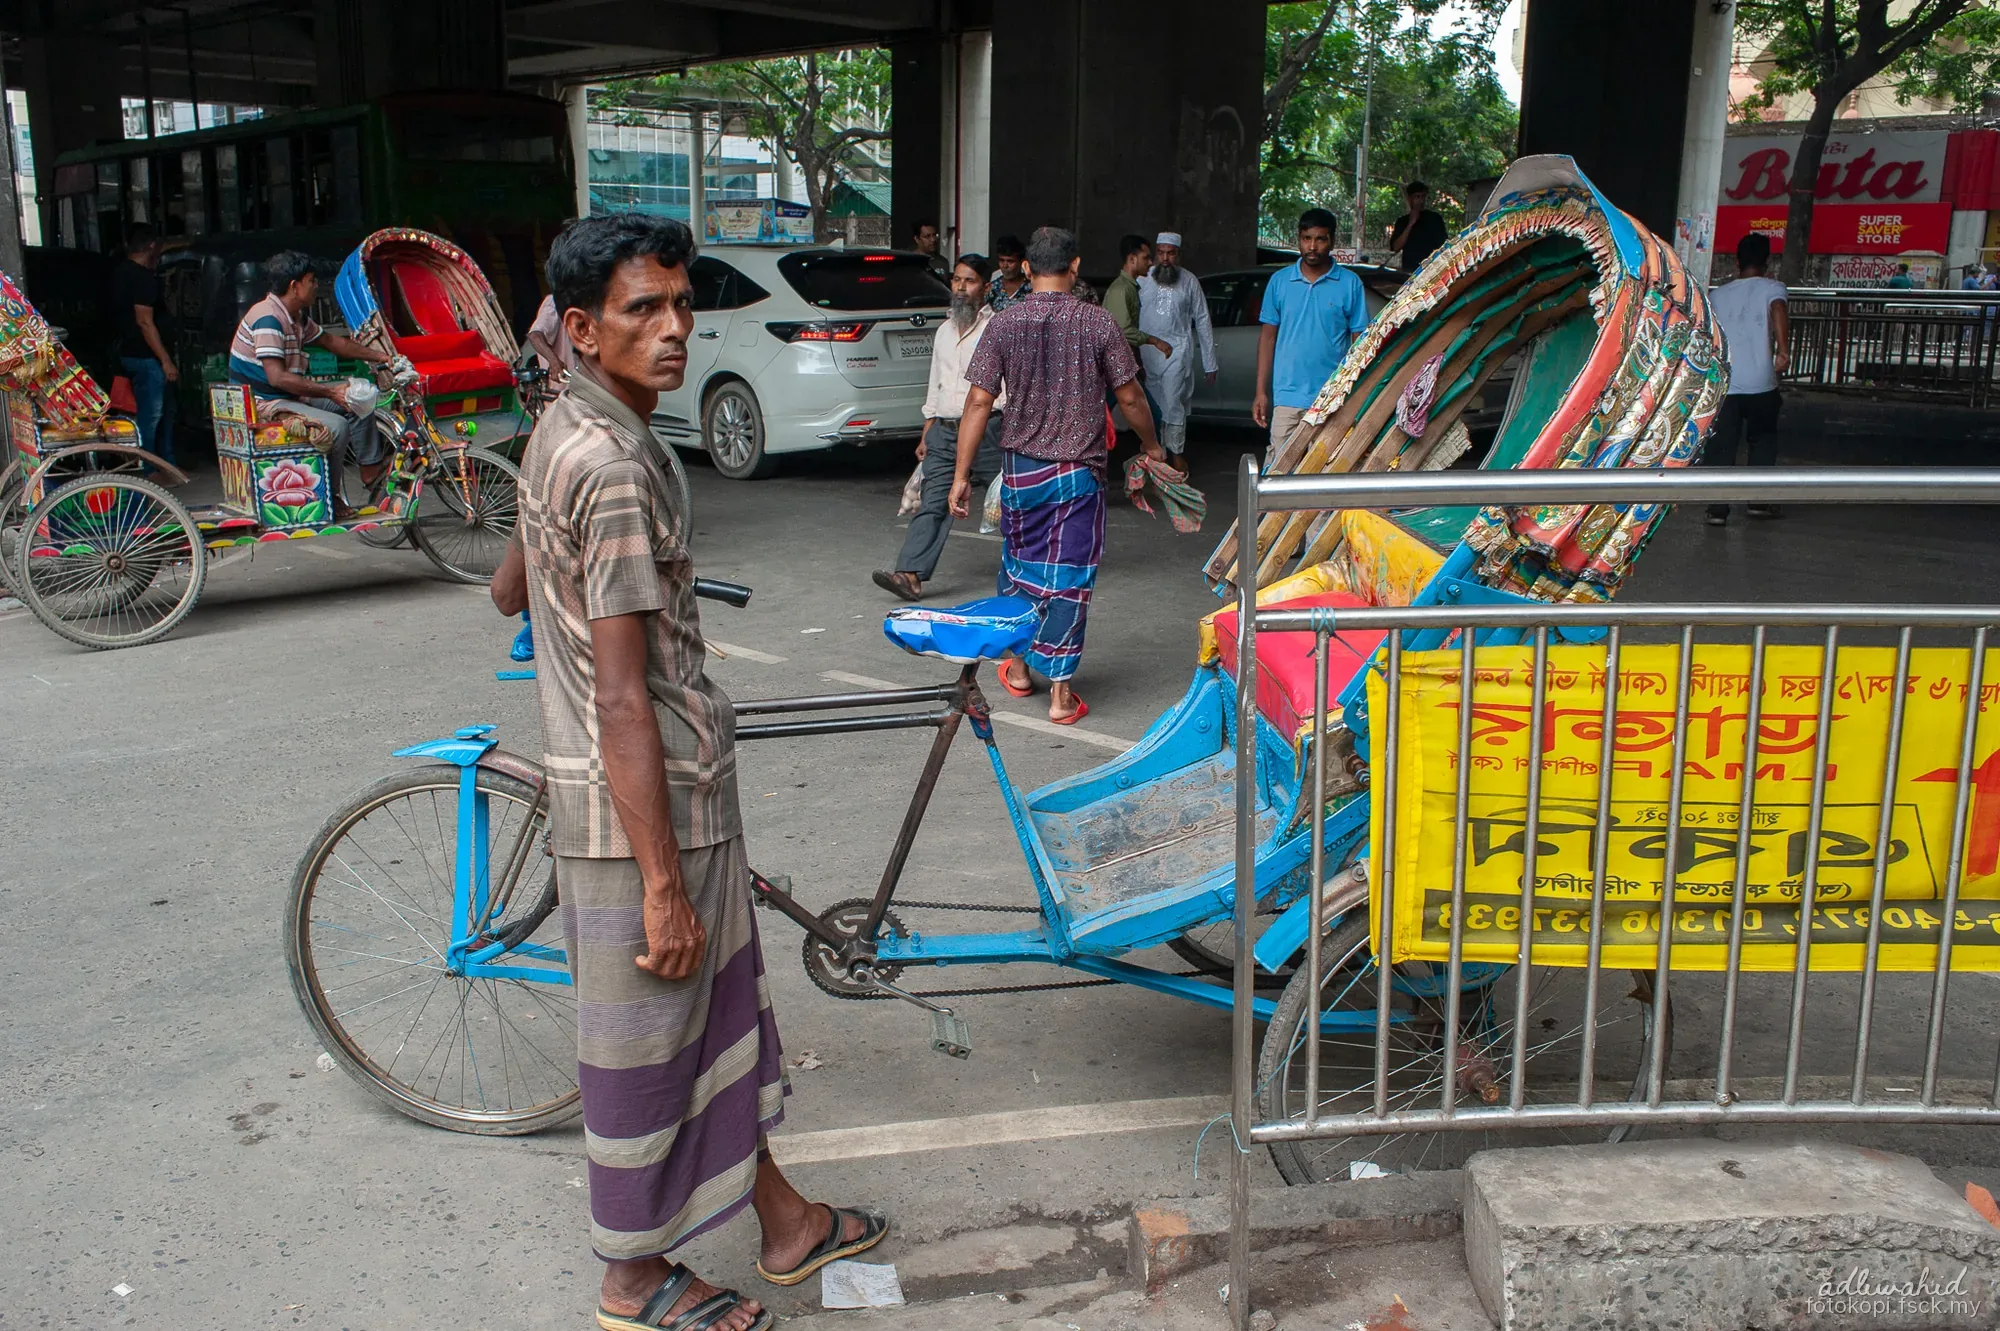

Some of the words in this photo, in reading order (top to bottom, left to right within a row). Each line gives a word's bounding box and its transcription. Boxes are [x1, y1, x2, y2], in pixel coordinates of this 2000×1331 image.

[1859, 215, 1902, 226] SUPER
[1858, 225, 1902, 235] SAVER
[1856, 234, 1901, 244] STORE
